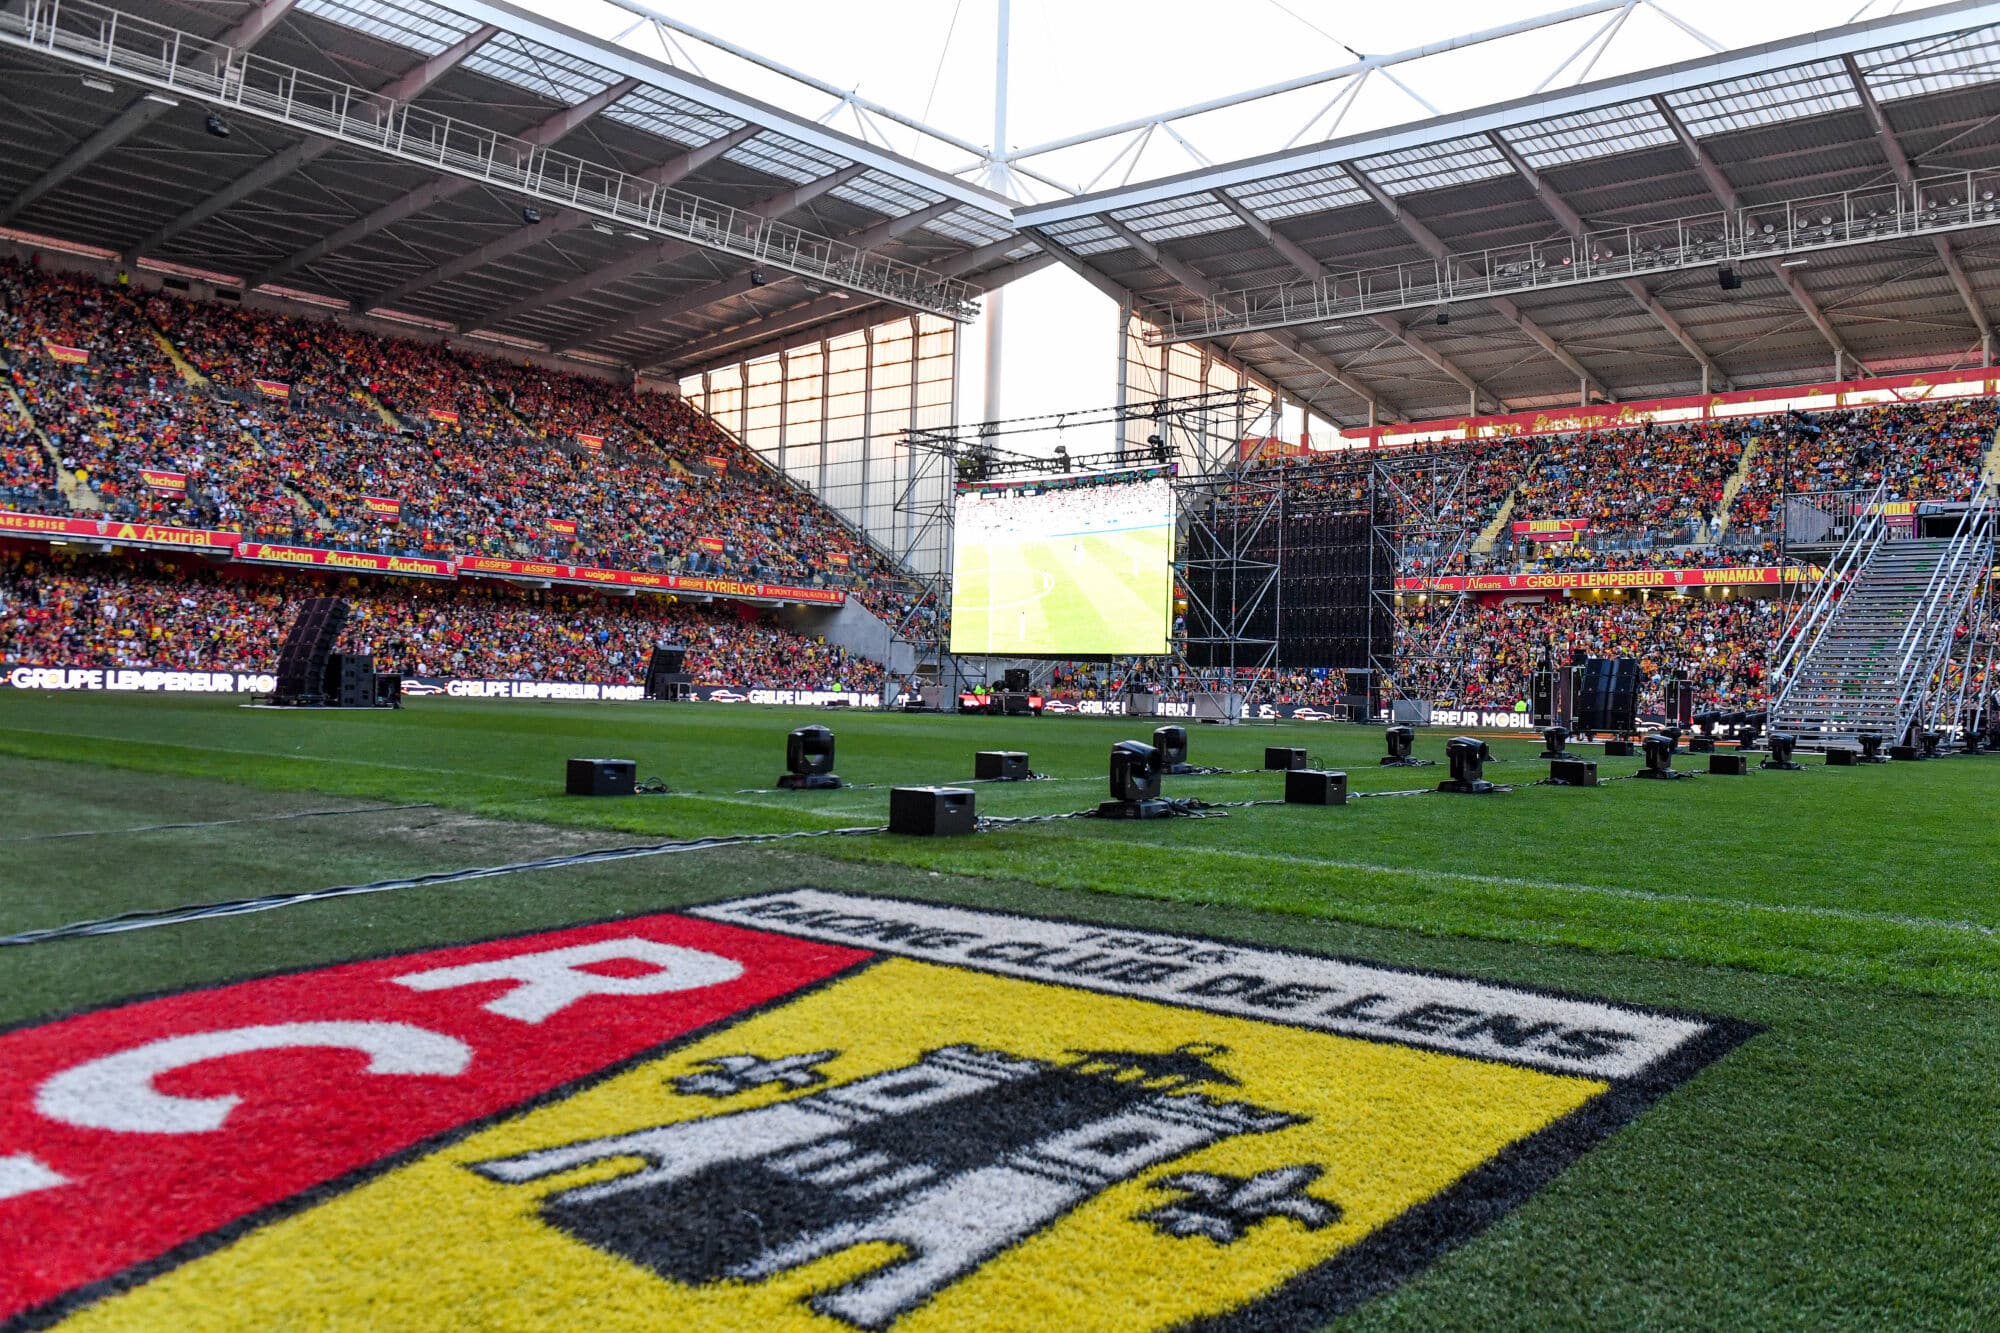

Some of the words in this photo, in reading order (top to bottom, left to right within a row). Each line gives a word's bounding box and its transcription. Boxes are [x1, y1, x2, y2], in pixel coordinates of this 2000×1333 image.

[143, 473, 185, 488] Auchan
[364, 500, 399, 512] Auchan
[0, 517, 66, 531] ARE-BRISE
[143, 526, 211, 545] Azurial
[258, 544, 314, 562] Auchan
[325, 551, 377, 568] Auchan
[387, 556, 436, 573] Auchan
[1466, 577, 1502, 589] Nexans
[1526, 575, 1577, 588] GROUPE
[1581, 571, 1664, 588] LEMPEREUR
[1703, 569, 1764, 583] WINAMAX
[706, 581, 756, 596] KYRIELYS
[11, 667, 103, 689] GROUPE
[106, 670, 233, 692] LEMPEREUR
[447, 680, 510, 697] GROUPE
[512, 681, 600, 699] LEMPEREUR
[727, 901, 984, 948] RACING
[966, 941, 1195, 984] CLUB
[1179, 972, 1338, 1008] DE
[1319, 994, 1640, 1060] LENS
